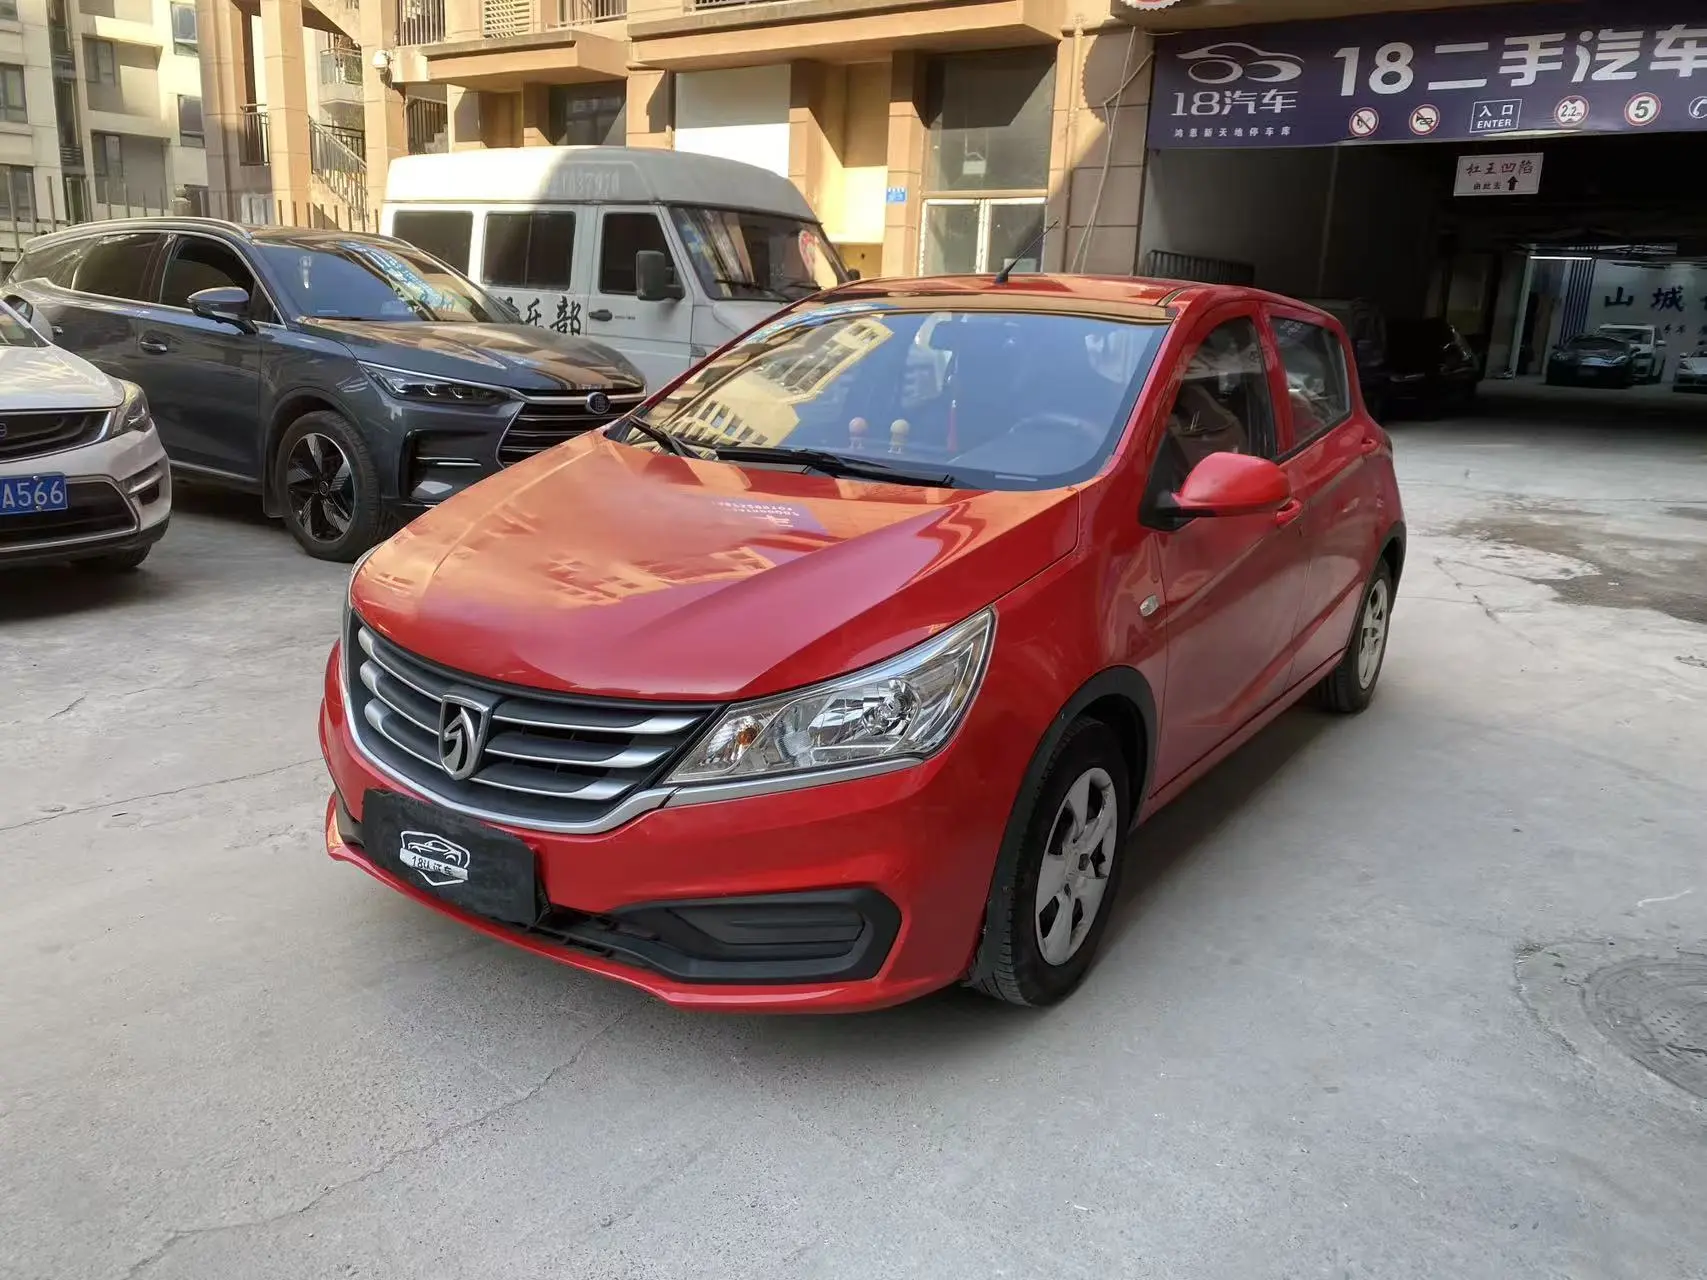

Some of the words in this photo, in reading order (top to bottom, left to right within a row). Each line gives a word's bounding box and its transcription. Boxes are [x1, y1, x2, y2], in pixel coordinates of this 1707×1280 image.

[1333, 24, 1707, 97] 18二手汽车
[1171, 88, 1298, 116] 18汽车
[1479, 104, 1514, 117] 入口
[1634, 100, 1649, 119] 5
[1477, 119, 1512, 129] ENTER
[2, 481, 64, 509] A566
